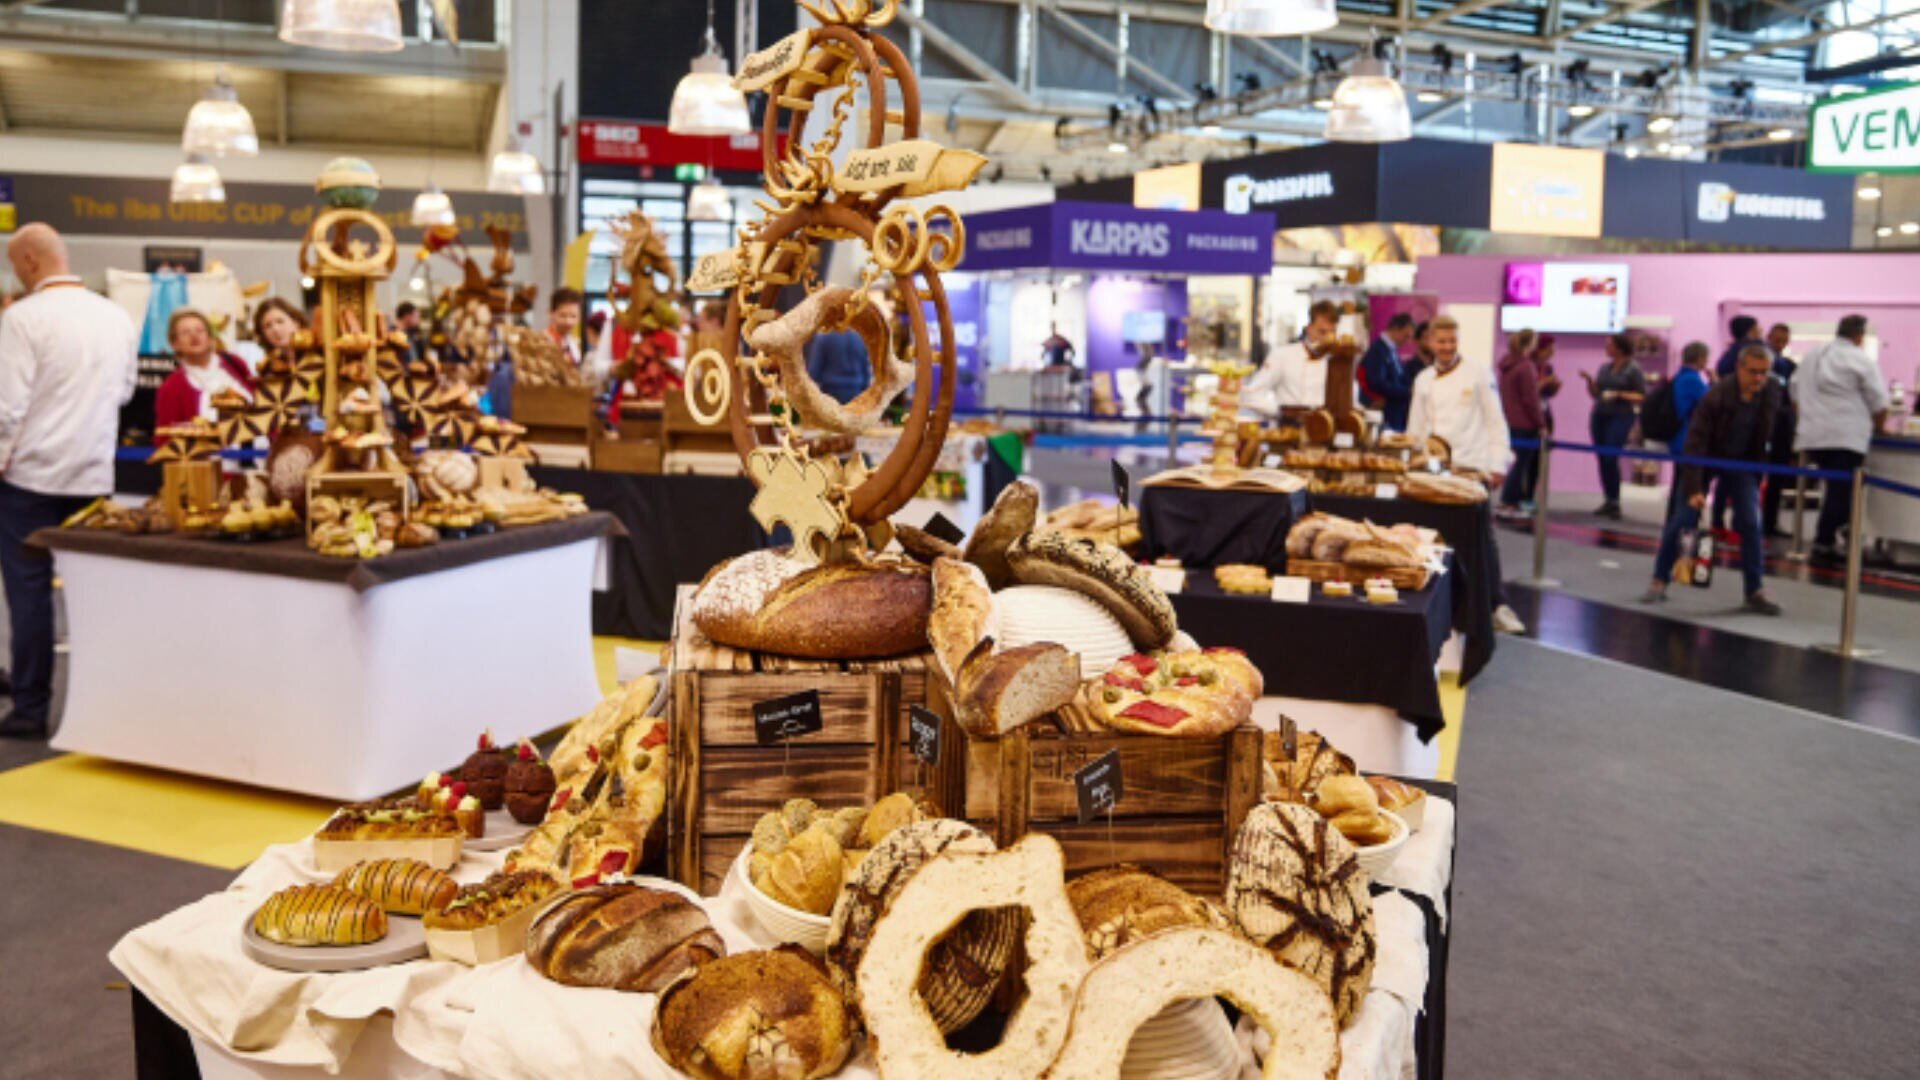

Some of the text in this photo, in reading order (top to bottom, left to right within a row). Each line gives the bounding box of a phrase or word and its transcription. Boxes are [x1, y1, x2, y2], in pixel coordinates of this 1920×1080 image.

[72, 196, 117, 219] The
[232, 202, 284, 225] CUP
[1071, 219, 1171, 257] KARPAS
